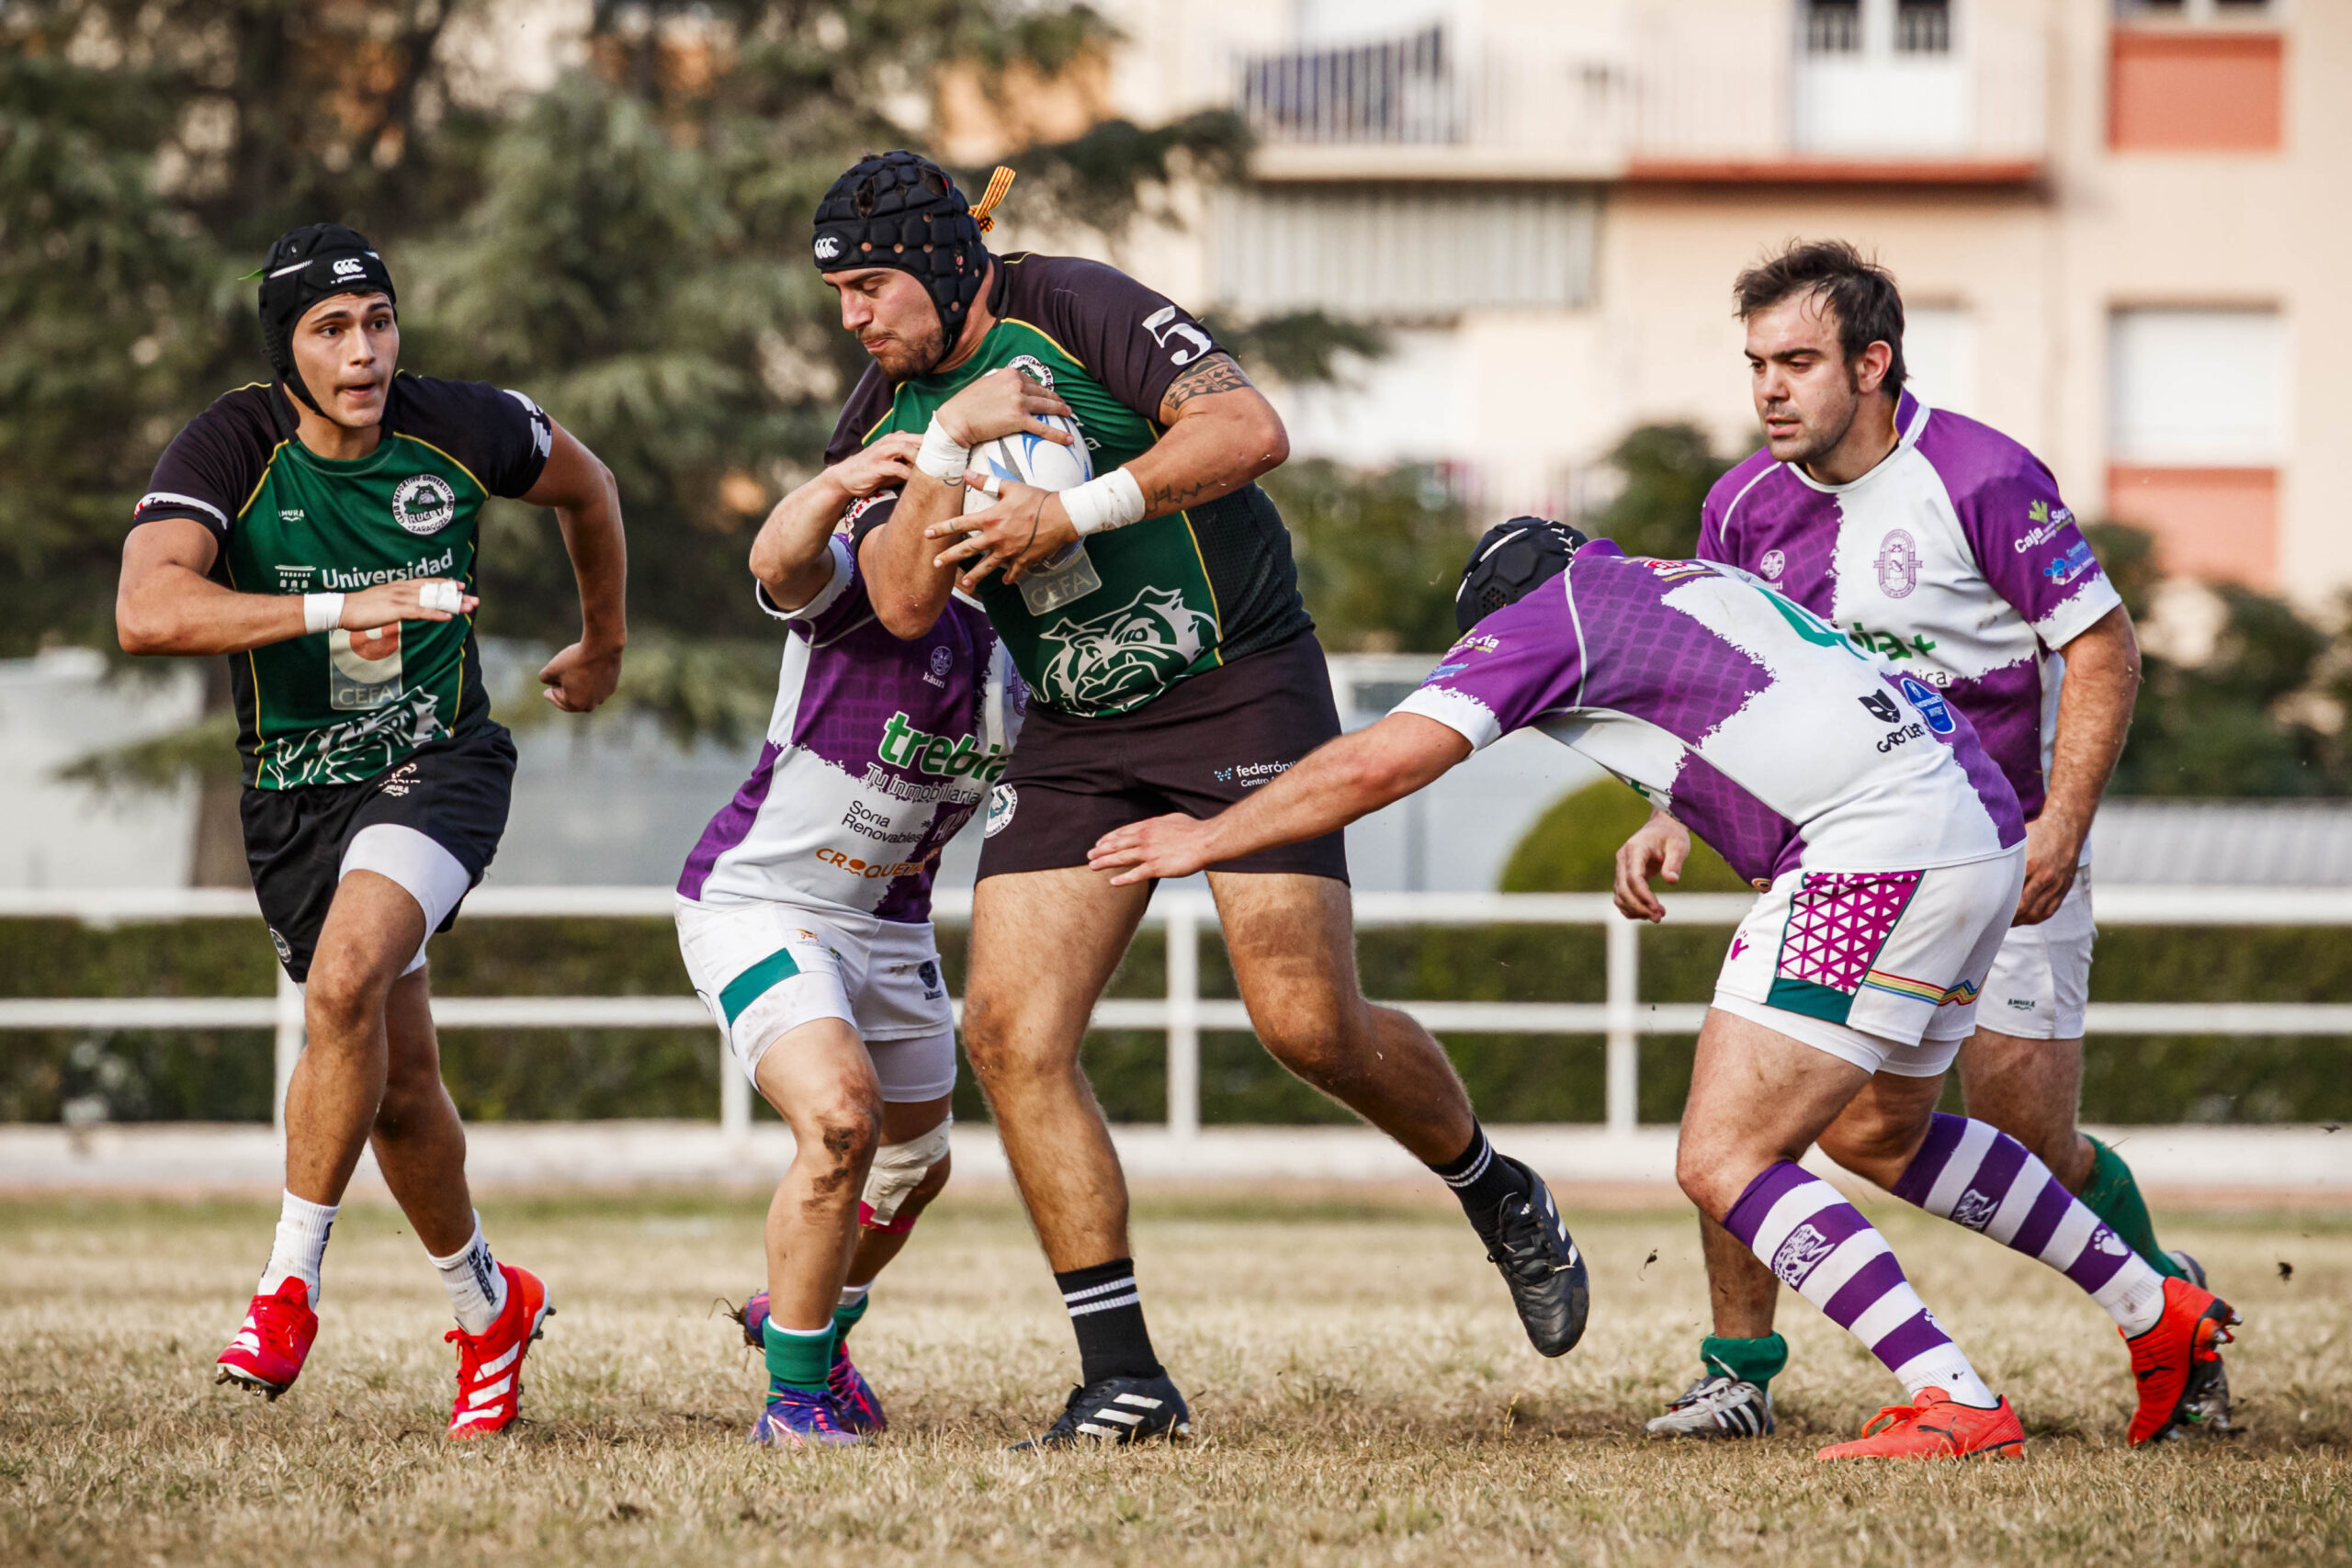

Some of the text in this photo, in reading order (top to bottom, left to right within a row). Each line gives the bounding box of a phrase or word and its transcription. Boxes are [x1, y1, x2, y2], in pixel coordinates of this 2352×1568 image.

[1142, 305, 1212, 366] 5
[322, 547, 454, 590] Universidad
[338, 686, 396, 705] CEFA
[867, 762, 888, 787] Tu
[889, 774, 981, 806] inmobiliaria
[841, 813, 922, 843] Renovables
[849, 800, 891, 828] Soria
